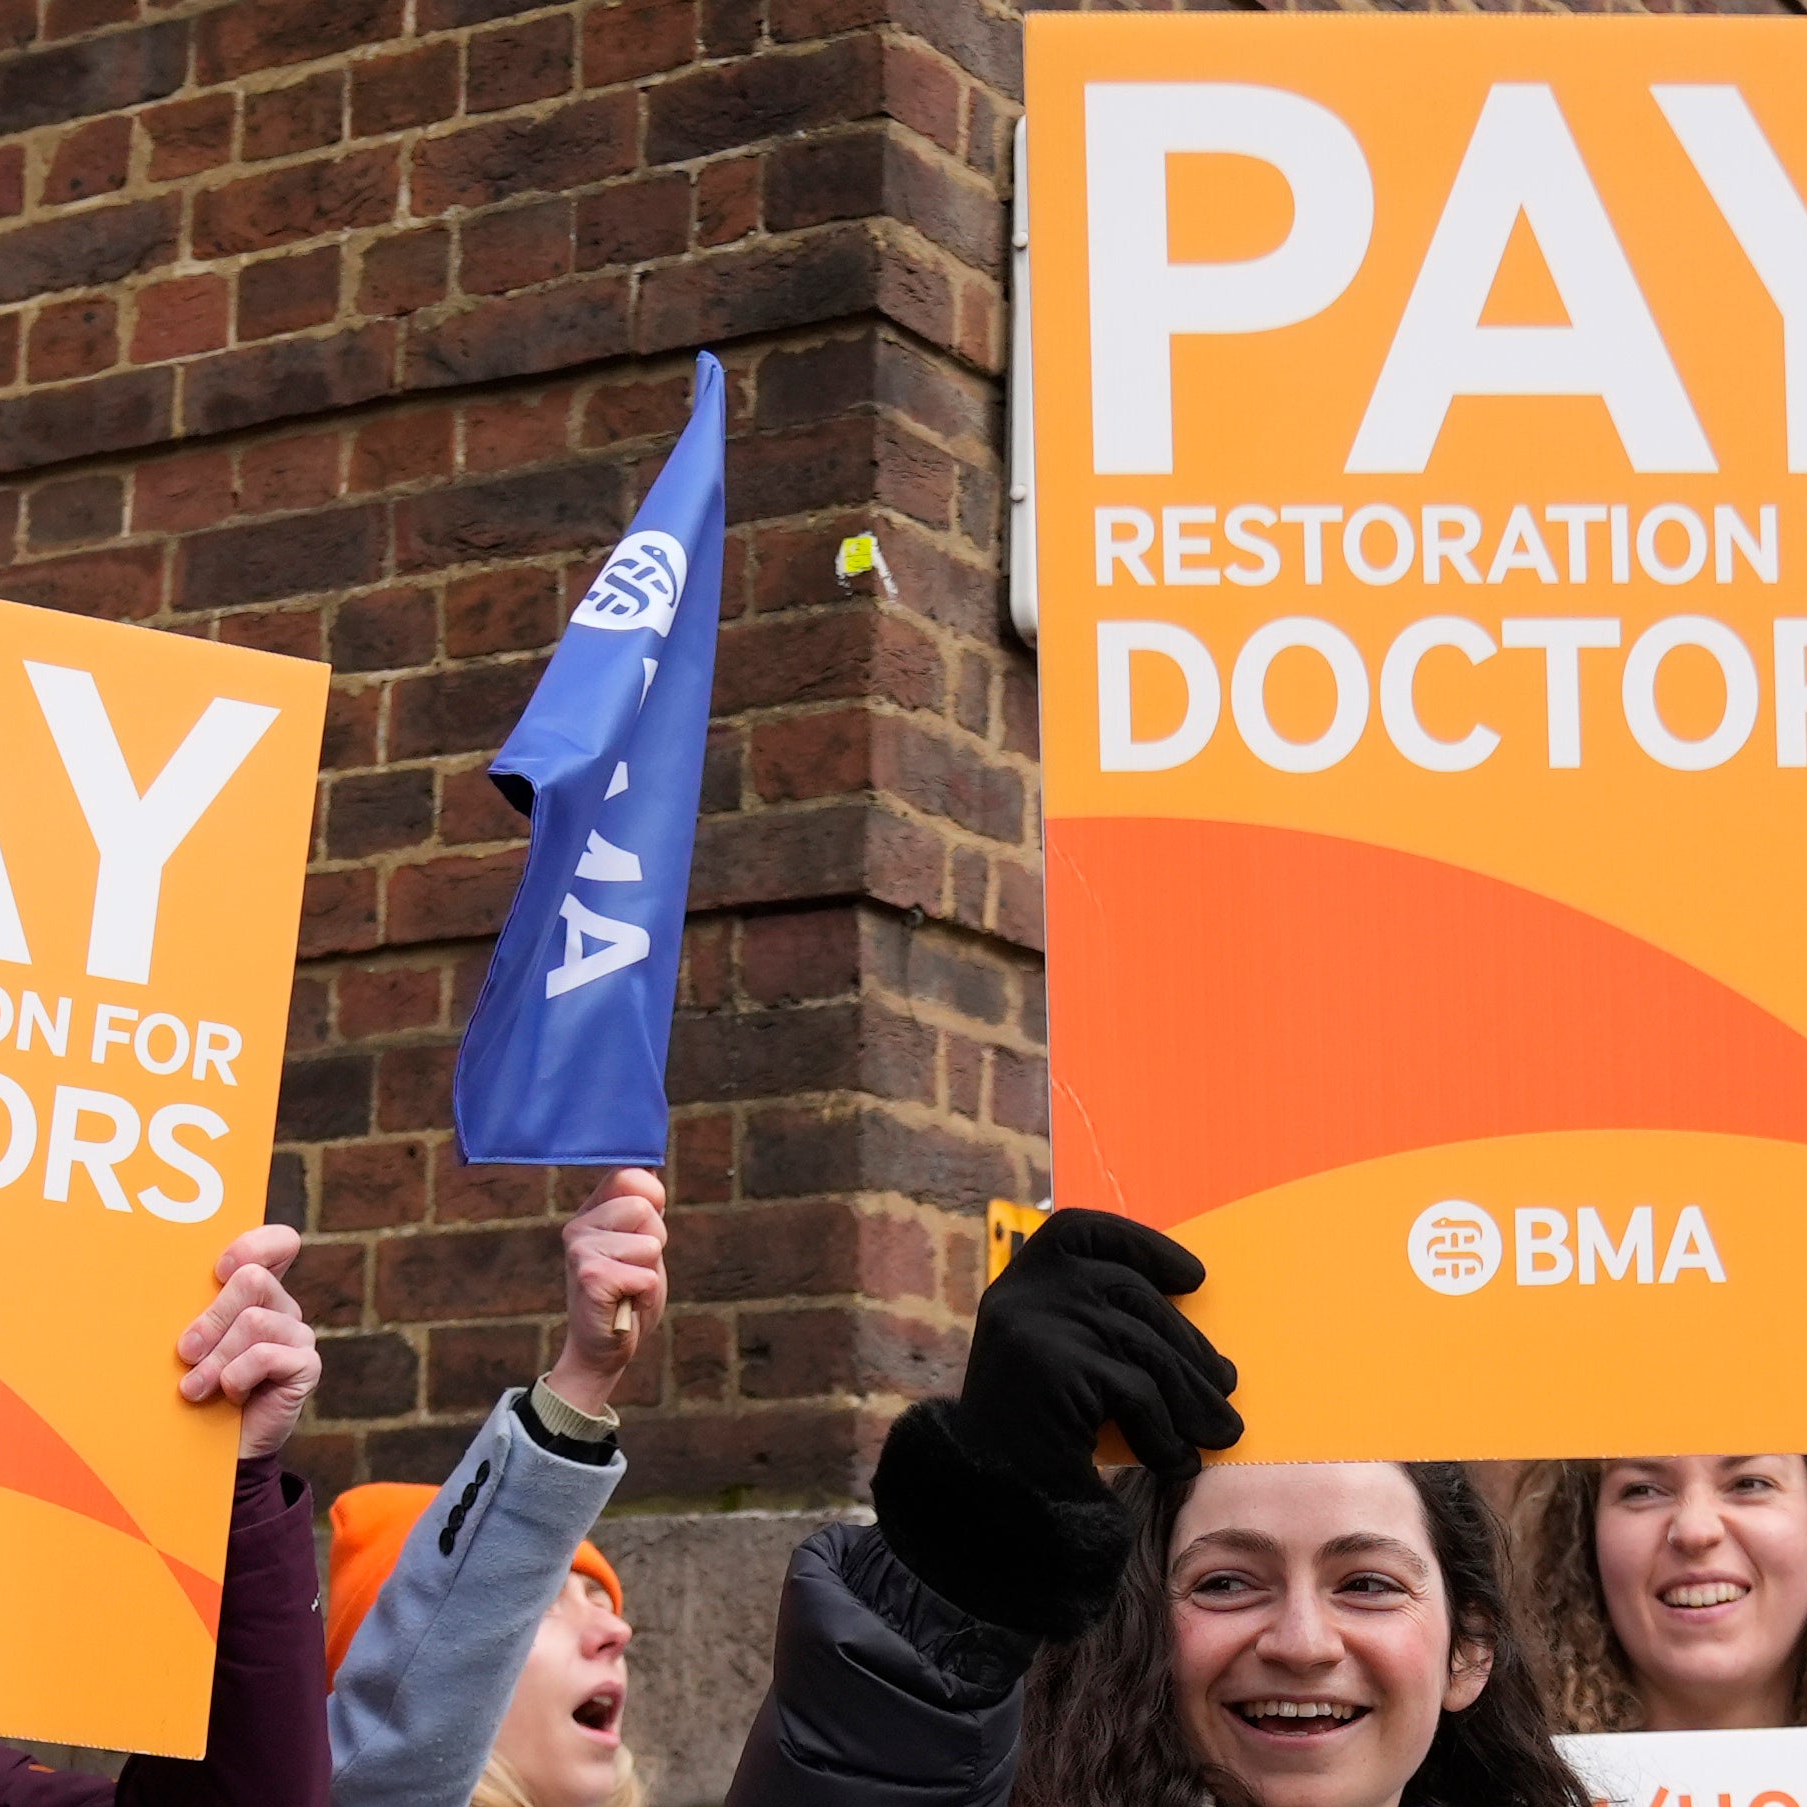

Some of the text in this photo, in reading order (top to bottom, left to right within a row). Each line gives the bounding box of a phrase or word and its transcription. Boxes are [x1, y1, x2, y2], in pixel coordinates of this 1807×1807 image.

[1095, 503, 1778, 588] RESTORATION
[91, 1011, 243, 1086] FOR
[1514, 1205, 1726, 1287] BMA
